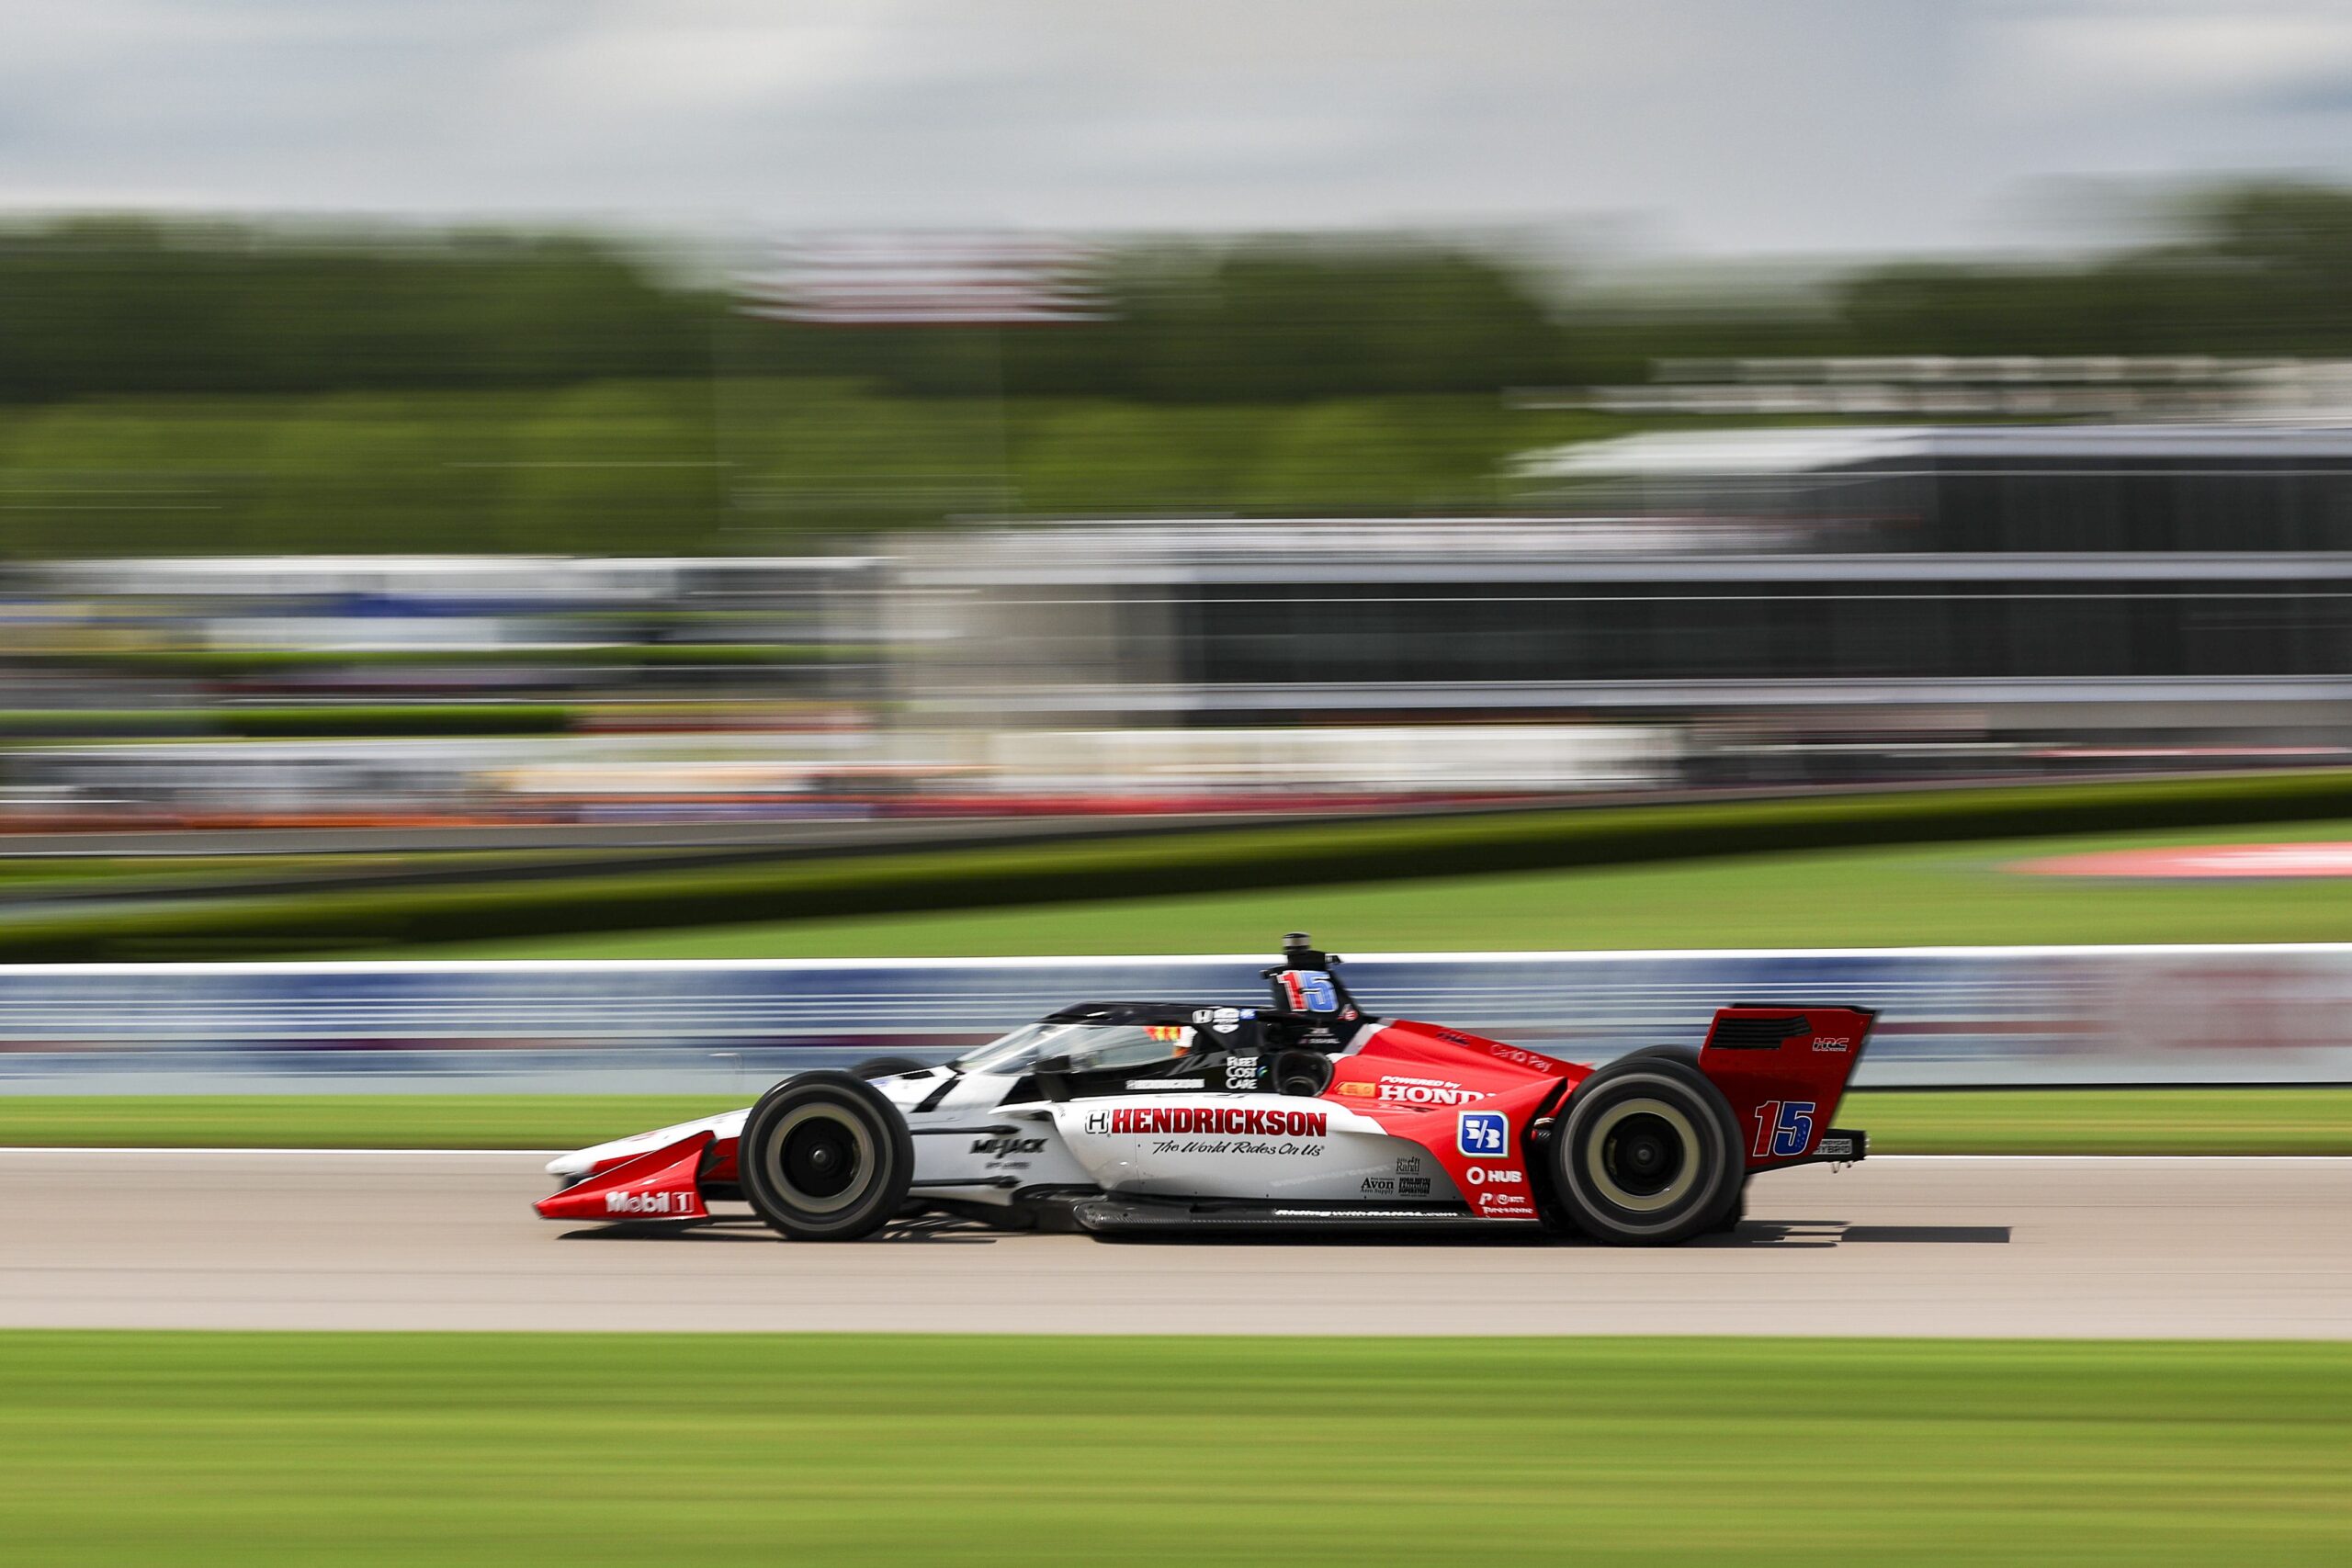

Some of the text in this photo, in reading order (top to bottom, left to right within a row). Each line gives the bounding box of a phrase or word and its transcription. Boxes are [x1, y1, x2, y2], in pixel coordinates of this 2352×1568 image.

[1276, 970, 1339, 1012] 15
[1812, 1037, 1849, 1050] HRC
[1227, 1056, 1259, 1066] FLEET
[1226, 1066, 1258, 1077] COST
[1380, 1075, 1443, 1087] POWERED
[1378, 1084, 1497, 1105] HOND
[1111, 1108, 1328, 1137] HENDRICKSON
[1753, 1100, 1815, 1157] 15
[1152, 1140, 1180, 1155] The
[1181, 1141, 1231, 1154] World
[1231, 1141, 1277, 1155] Rides
[1278, 1142, 1301, 1156] On
[1361, 1177, 1395, 1190] Avon
[1487, 1169, 1522, 1183] HUB
[605, 1190, 670, 1213] Mobil
